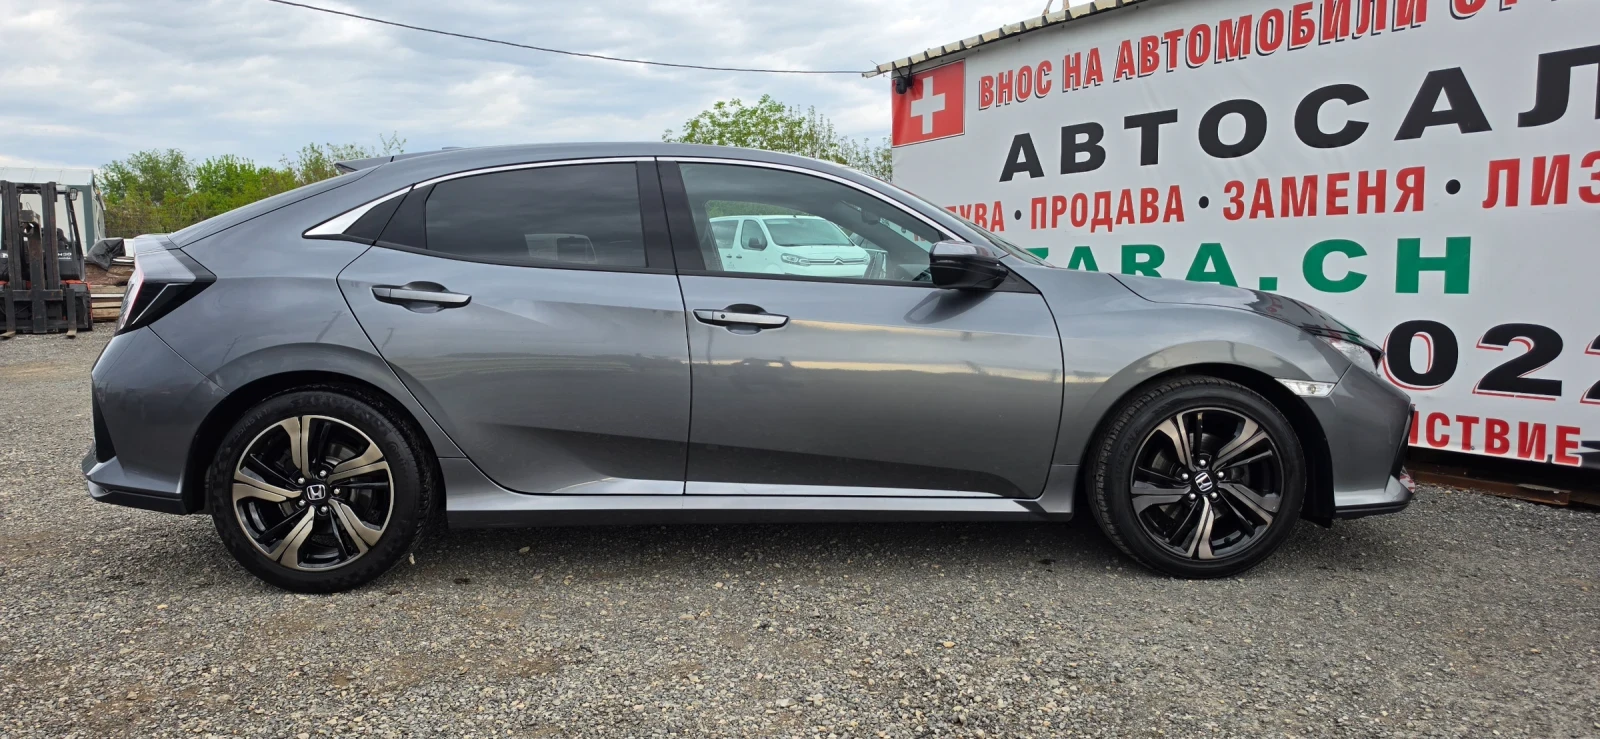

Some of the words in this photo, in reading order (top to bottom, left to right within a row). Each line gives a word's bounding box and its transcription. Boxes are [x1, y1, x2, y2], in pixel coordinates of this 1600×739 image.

[979, 60, 1052, 110] ВНОС
[1062, 48, 1103, 93] НА
[1113, 0, 1428, 82] АВТОМОБИЛИ
[999, 45, 1600, 182] АВТОСАЛ
[1030, 185, 1185, 233] ПРОДАВА
[1222, 166, 1426, 221] ЗАМЕНЯ
[1025, 236, 1471, 294] ARA.CH
[1382, 320, 1600, 405] 02
